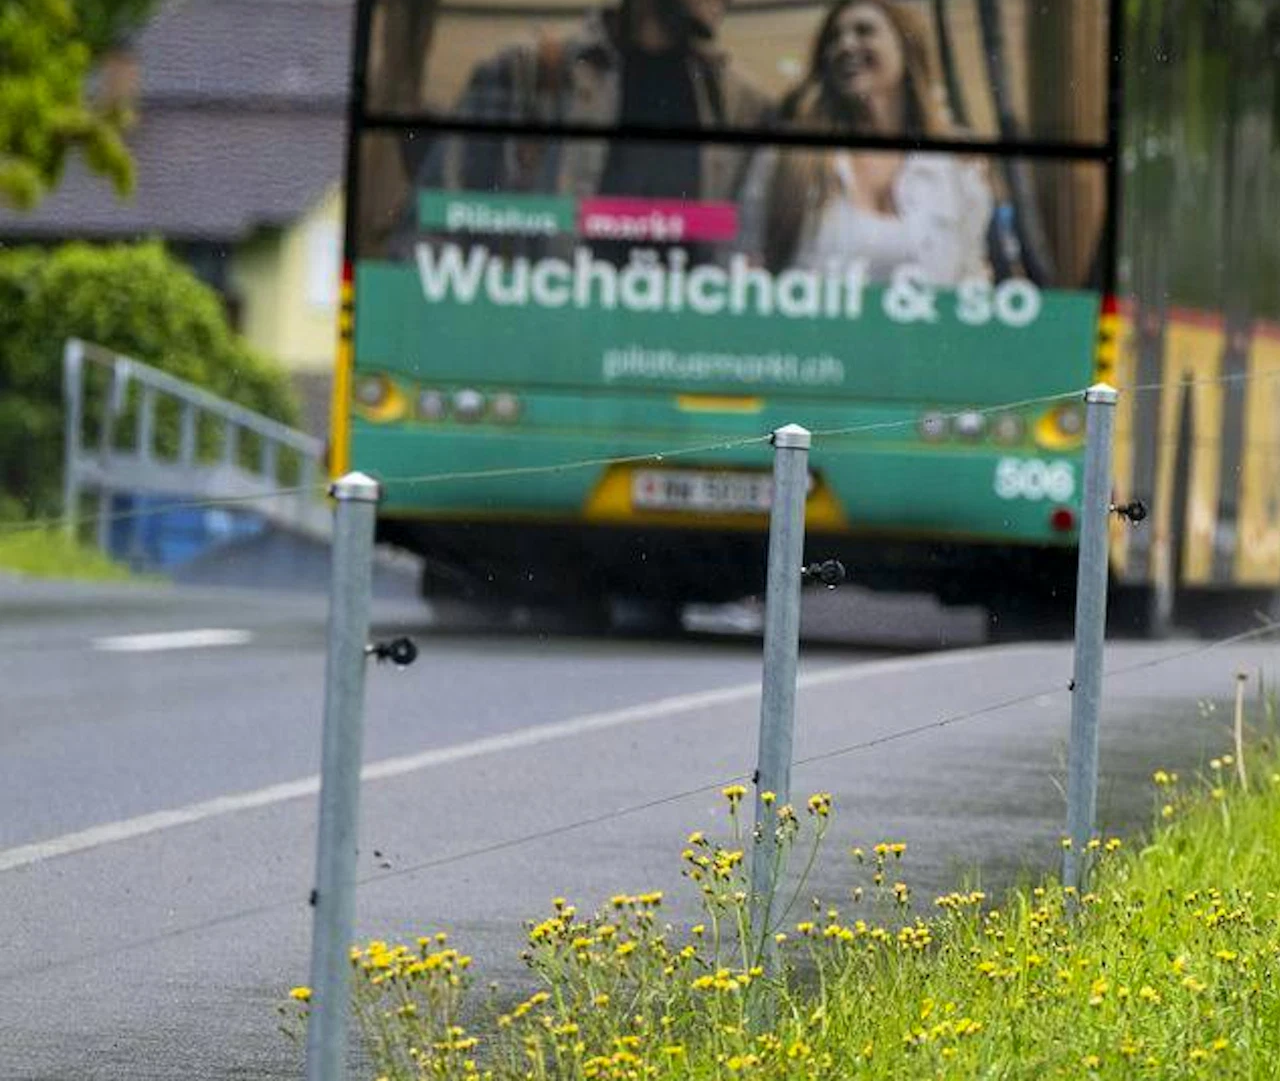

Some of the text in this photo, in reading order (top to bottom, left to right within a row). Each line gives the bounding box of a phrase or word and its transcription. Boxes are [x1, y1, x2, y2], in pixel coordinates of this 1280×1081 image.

[583, 208, 685, 239] markt
[881, 263, 938, 324] &
[954, 275, 1042, 327] so
[994, 457, 1075, 502] 506
